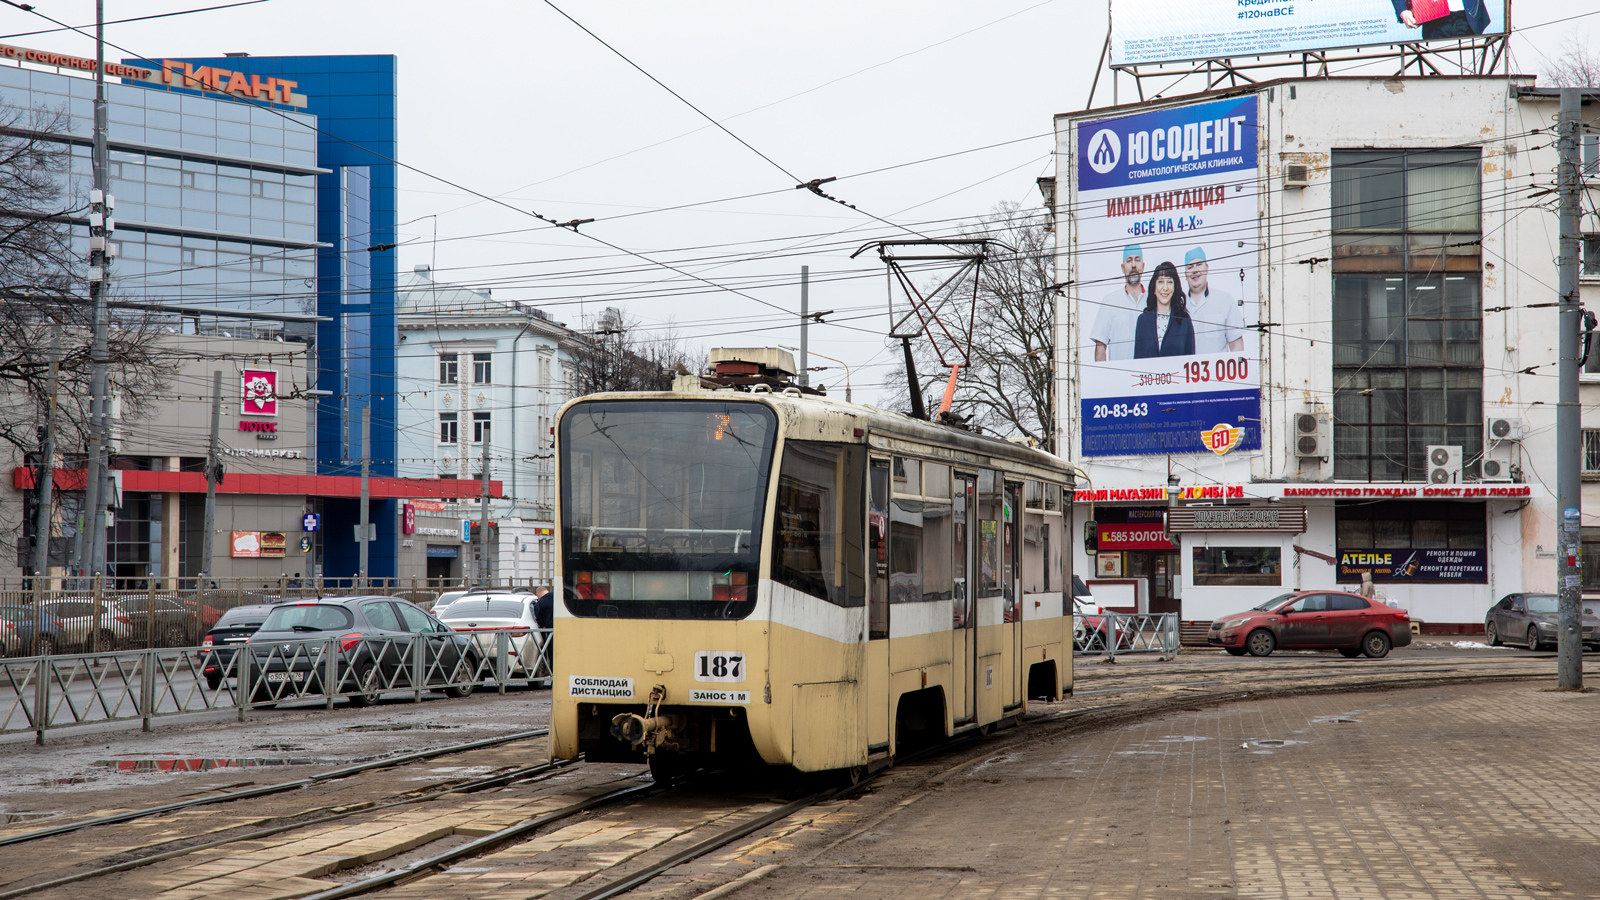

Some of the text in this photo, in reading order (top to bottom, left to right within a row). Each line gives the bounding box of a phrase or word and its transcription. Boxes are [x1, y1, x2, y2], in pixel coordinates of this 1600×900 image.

[1237, 5, 1294, 19] #120наВСЁ
[162, 59, 298, 103] ГИГАНТ
[1128, 115, 1246, 165] ЮСОДЕНТ
[1128, 156, 1244, 179] СТОМАТОЛОГИЧЕСКАЯ КЛИНИКА
[1107, 185, 1225, 218] ИМПЛАНТАЦИЯ
[1159, 218, 1174, 233] НА
[1140, 358, 1248, 386] 310 000 193 000
[1093, 402, 1148, 418] 20-83-63
[239, 421, 278, 432] ЛОТОС
[1211, 429, 1230, 449] GD
[217, 448, 301, 459] УПЕРМАРКЕТ
[1073, 489, 1107, 501] РНЫЙ
[1109, 488, 1162, 500] МАГАЗИН
[1185, 486, 1244, 498] ЛОМБАРД
[1284, 486, 1530, 497] БАНКРОТСТВО ГРАЖДАН ЮРИСТ ДЛЯ ЛЮДЕЙ
[1236, 510, 1279, 521] РЕСТОРАН
[1341, 553, 1392, 565] АТЕЛЬЕ
[699, 655, 743, 677] 187
[574, 678, 628, 688] СОБЛЮДАЙ
[571, 687, 632, 697] ДИСТАНЦИЮ
[694, 692, 727, 700] ЗАНОС
[738, 693, 746, 701] М
